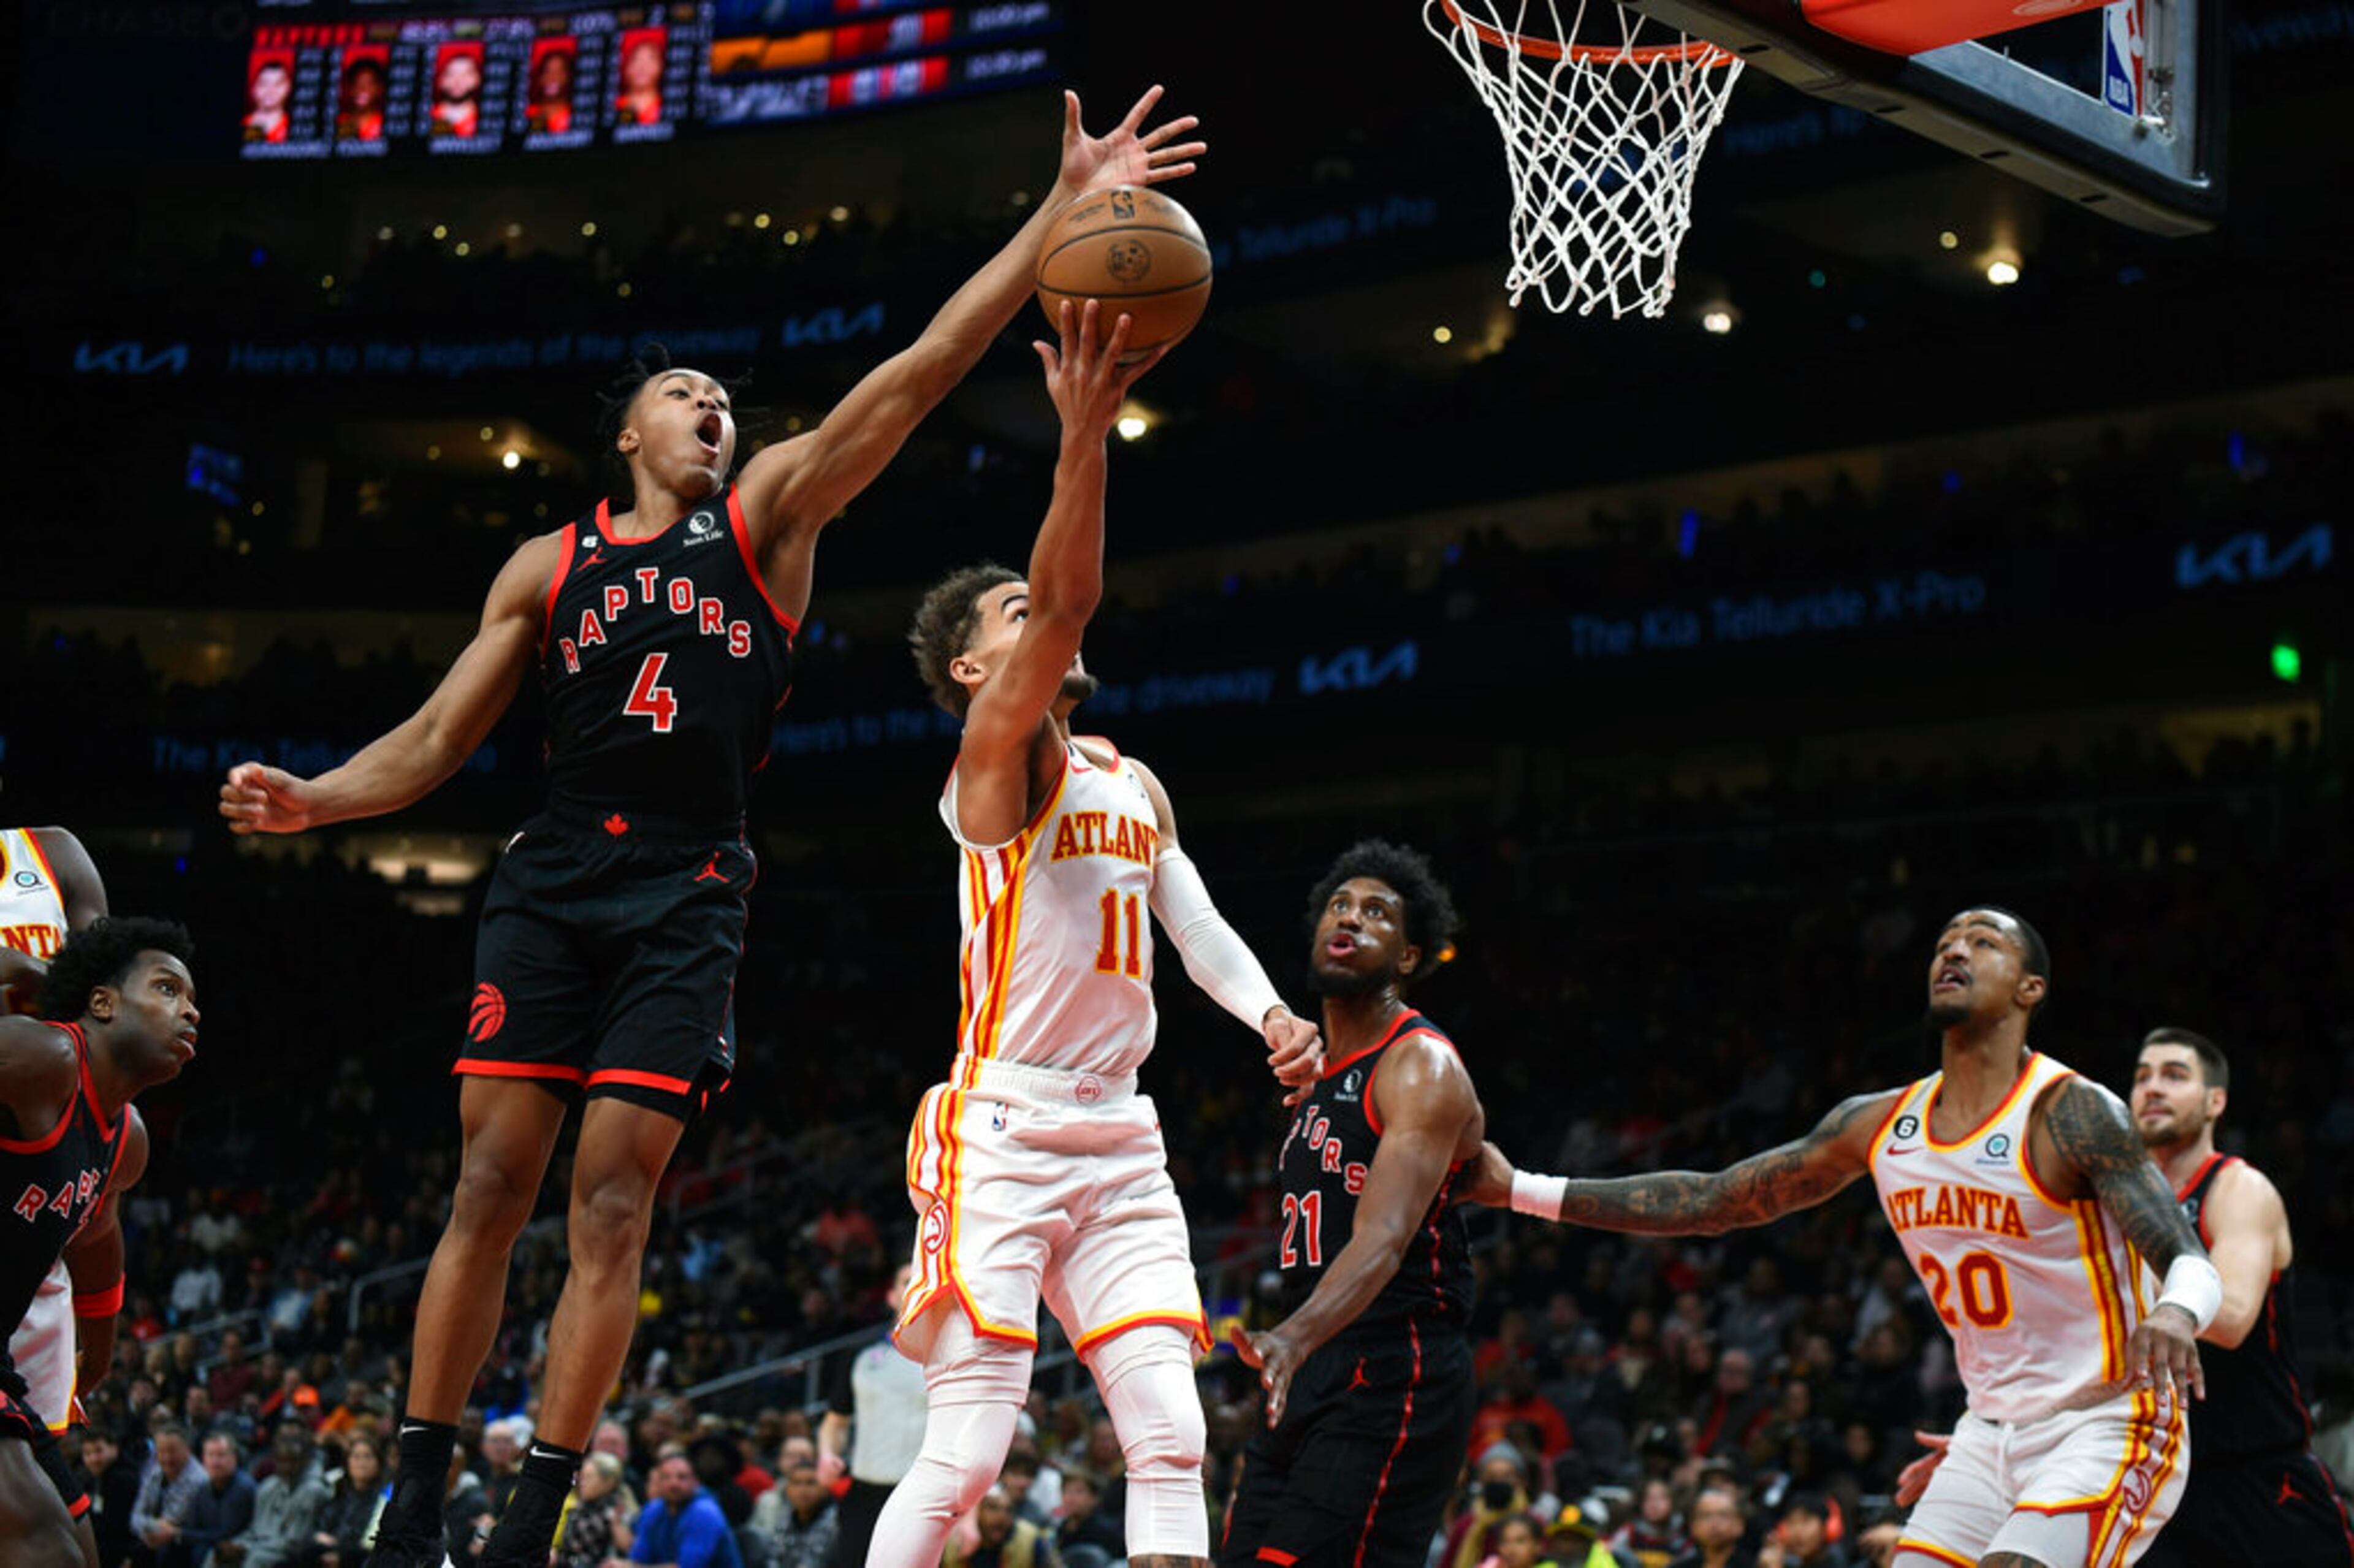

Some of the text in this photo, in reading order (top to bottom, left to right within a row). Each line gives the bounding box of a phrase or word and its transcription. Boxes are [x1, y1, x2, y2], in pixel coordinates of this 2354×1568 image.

[558, 566, 752, 674] RAPTORS
[1568, 614, 1637, 658] The
[622, 652, 678, 734] 4
[1094, 886, 1141, 980] 11
[1279, 1104, 1368, 1196] TORS
[1897, 1117, 1915, 1137] 6
[1279, 1189, 1322, 1270] 21
[1919, 1250, 2013, 1329] 20
